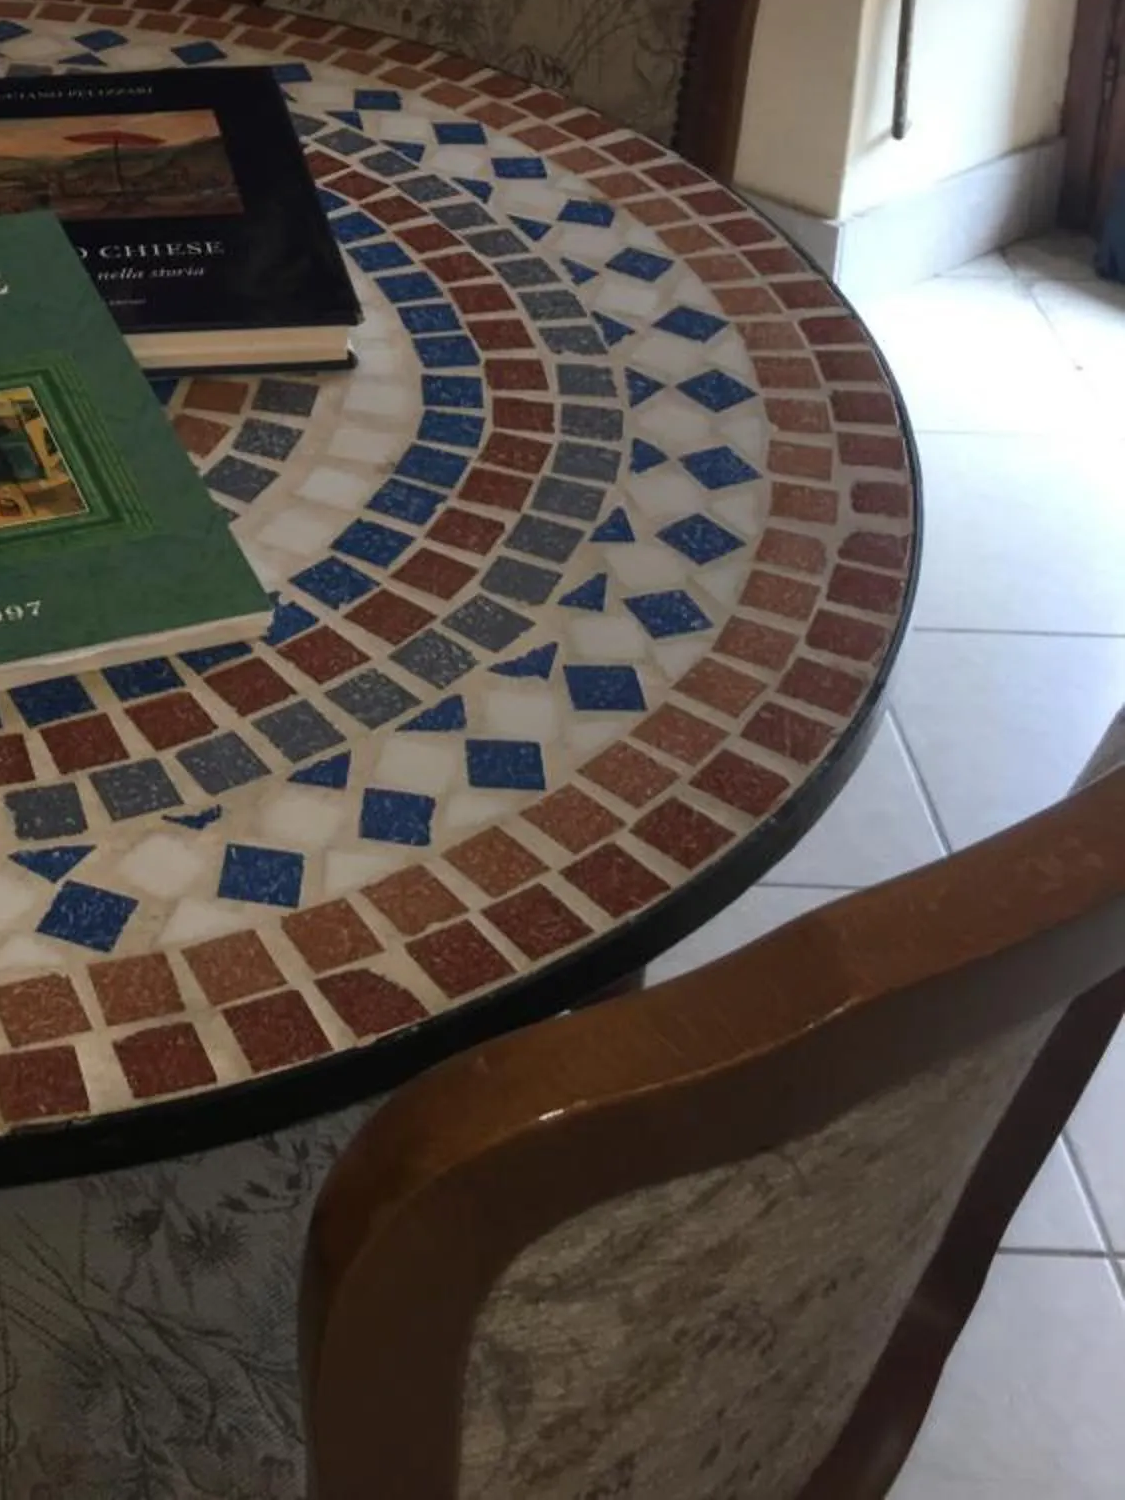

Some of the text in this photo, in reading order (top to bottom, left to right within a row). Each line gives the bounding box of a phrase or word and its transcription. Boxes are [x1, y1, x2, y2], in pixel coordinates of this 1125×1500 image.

[98, 241, 225, 259] CHIESE
[97, 265, 206, 281] nella storia
